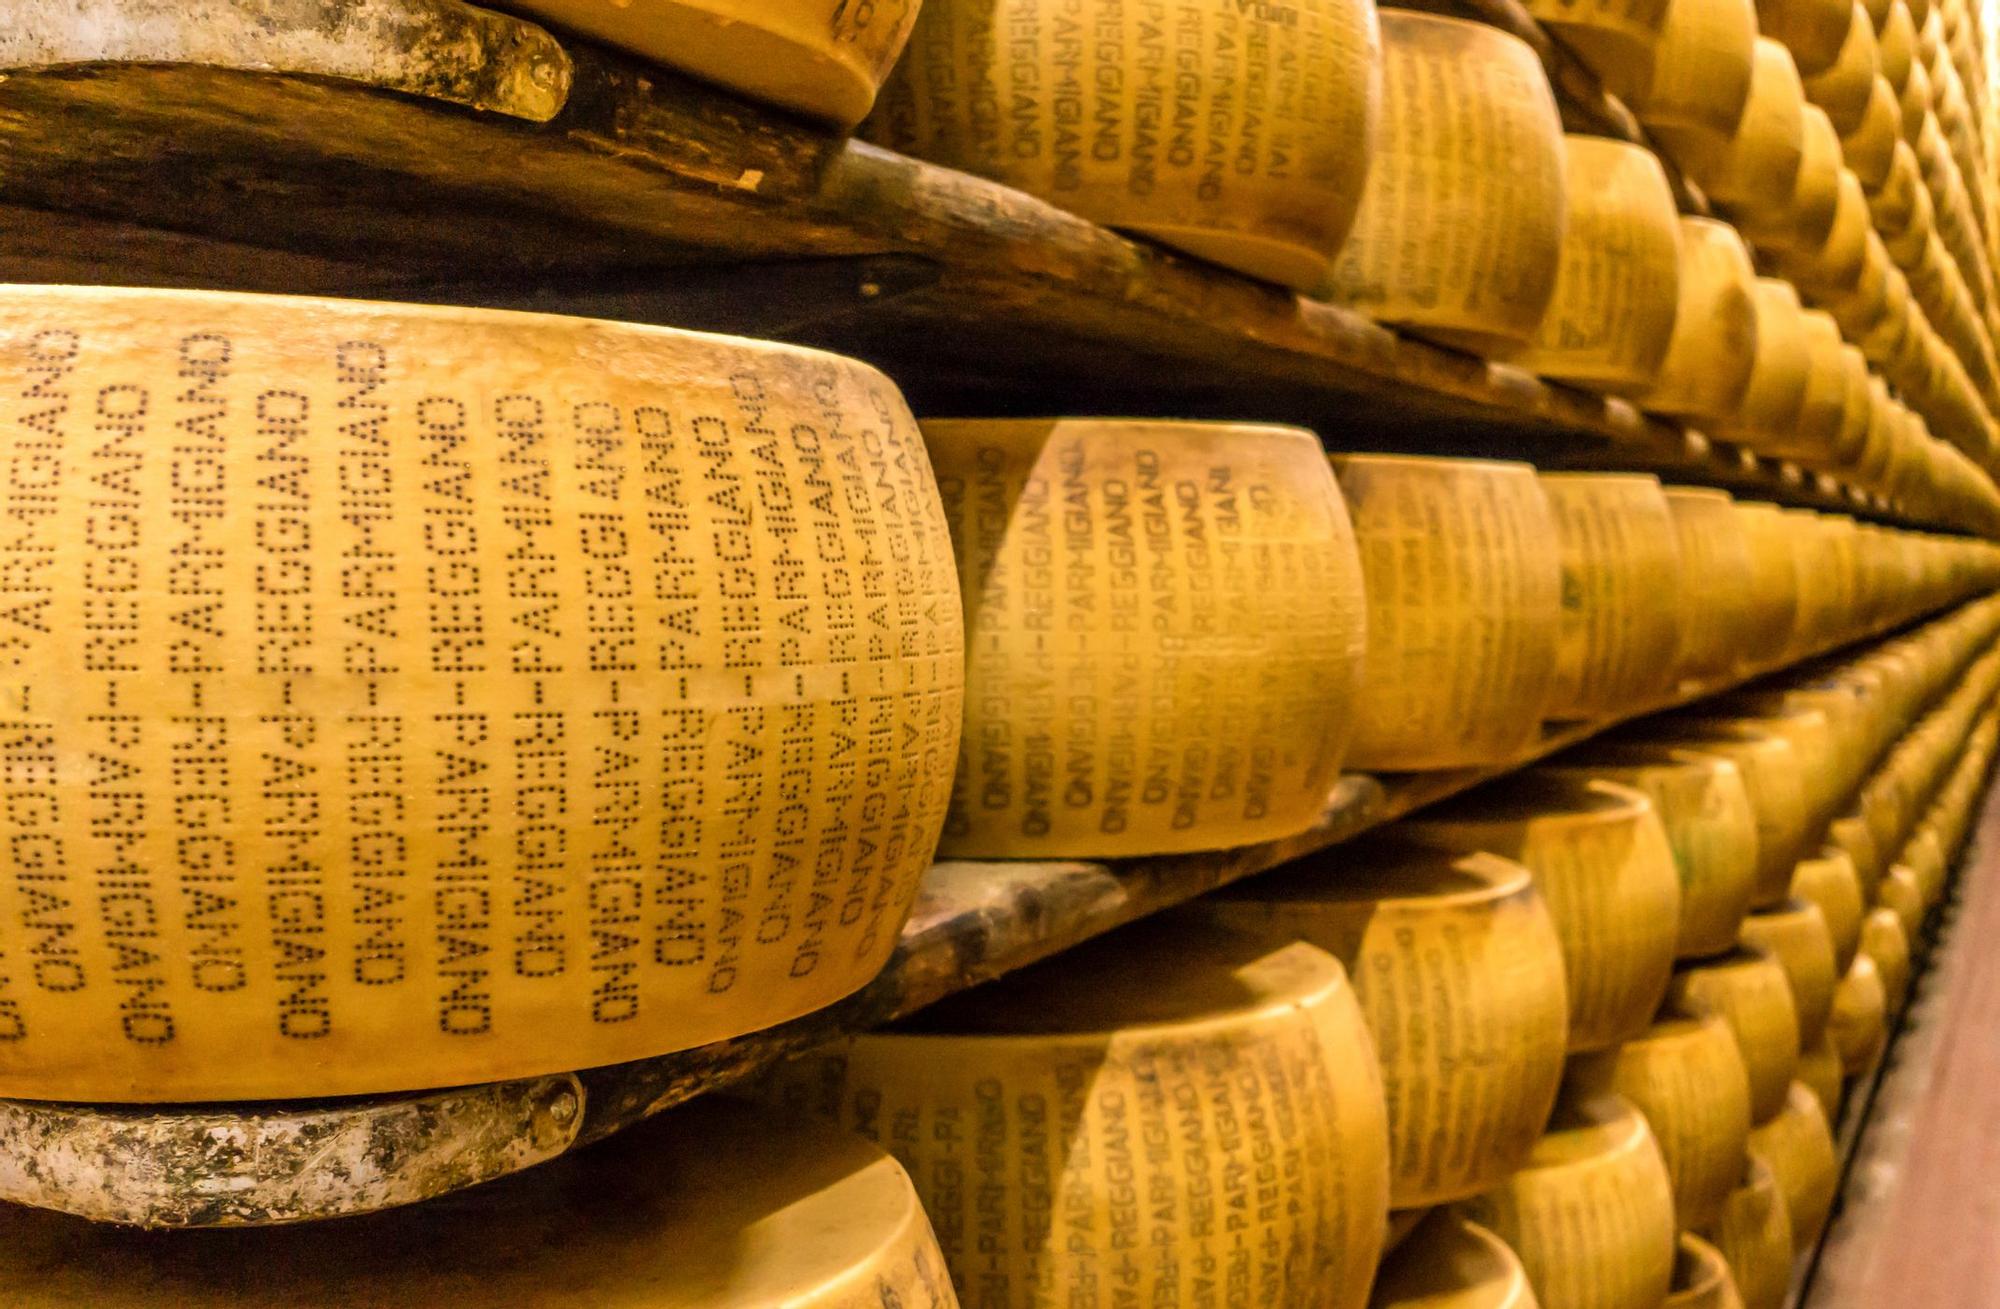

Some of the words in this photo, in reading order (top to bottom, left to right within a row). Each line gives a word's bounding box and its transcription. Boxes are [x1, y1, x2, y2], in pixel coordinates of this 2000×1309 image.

[1167, 8, 1200, 167] REGGIANO
[0, 329, 79, 668] ARMIGIANO
[85, 383, 148, 673] REGGIANO
[168, 331, 231, 674] PARMIGIANO
[256, 388, 313, 674] REGGIANO
[336, 339, 400, 674] PARMIGIANO
[416, 394, 487, 674] REGGIANO
[690, 415, 763, 669] REGGIANO
[729, 372, 813, 668] PARMIGIANO
[789, 422, 858, 664] REGGIANO
[1022, 478, 1055, 632] REGGIANO
[1102, 478, 1139, 632] REGGIANO
[0, 721, 87, 993] REGGIANO
[86, 714, 177, 1046] PARMIGIANO
[171, 714, 248, 993] REGGIANO
[259, 714, 332, 1041] PARMIGIANO
[346, 714, 407, 987] REGGIANO
[434, 712, 491, 1036] PARMIGIANO
[514, 710, 566, 980] REGGIANO
[589, 709, 643, 1024] PARMIGIANO
[654, 707, 706, 968] REGGIANO
[706, 706, 764, 996] PARMIGIANO
[755, 701, 815, 946] REGGIANO
[788, 698, 857, 980] PARMIGIANO
[838, 694, 893, 930] REGGIANO
[1099, 1088, 1140, 1253] REGGIANO
